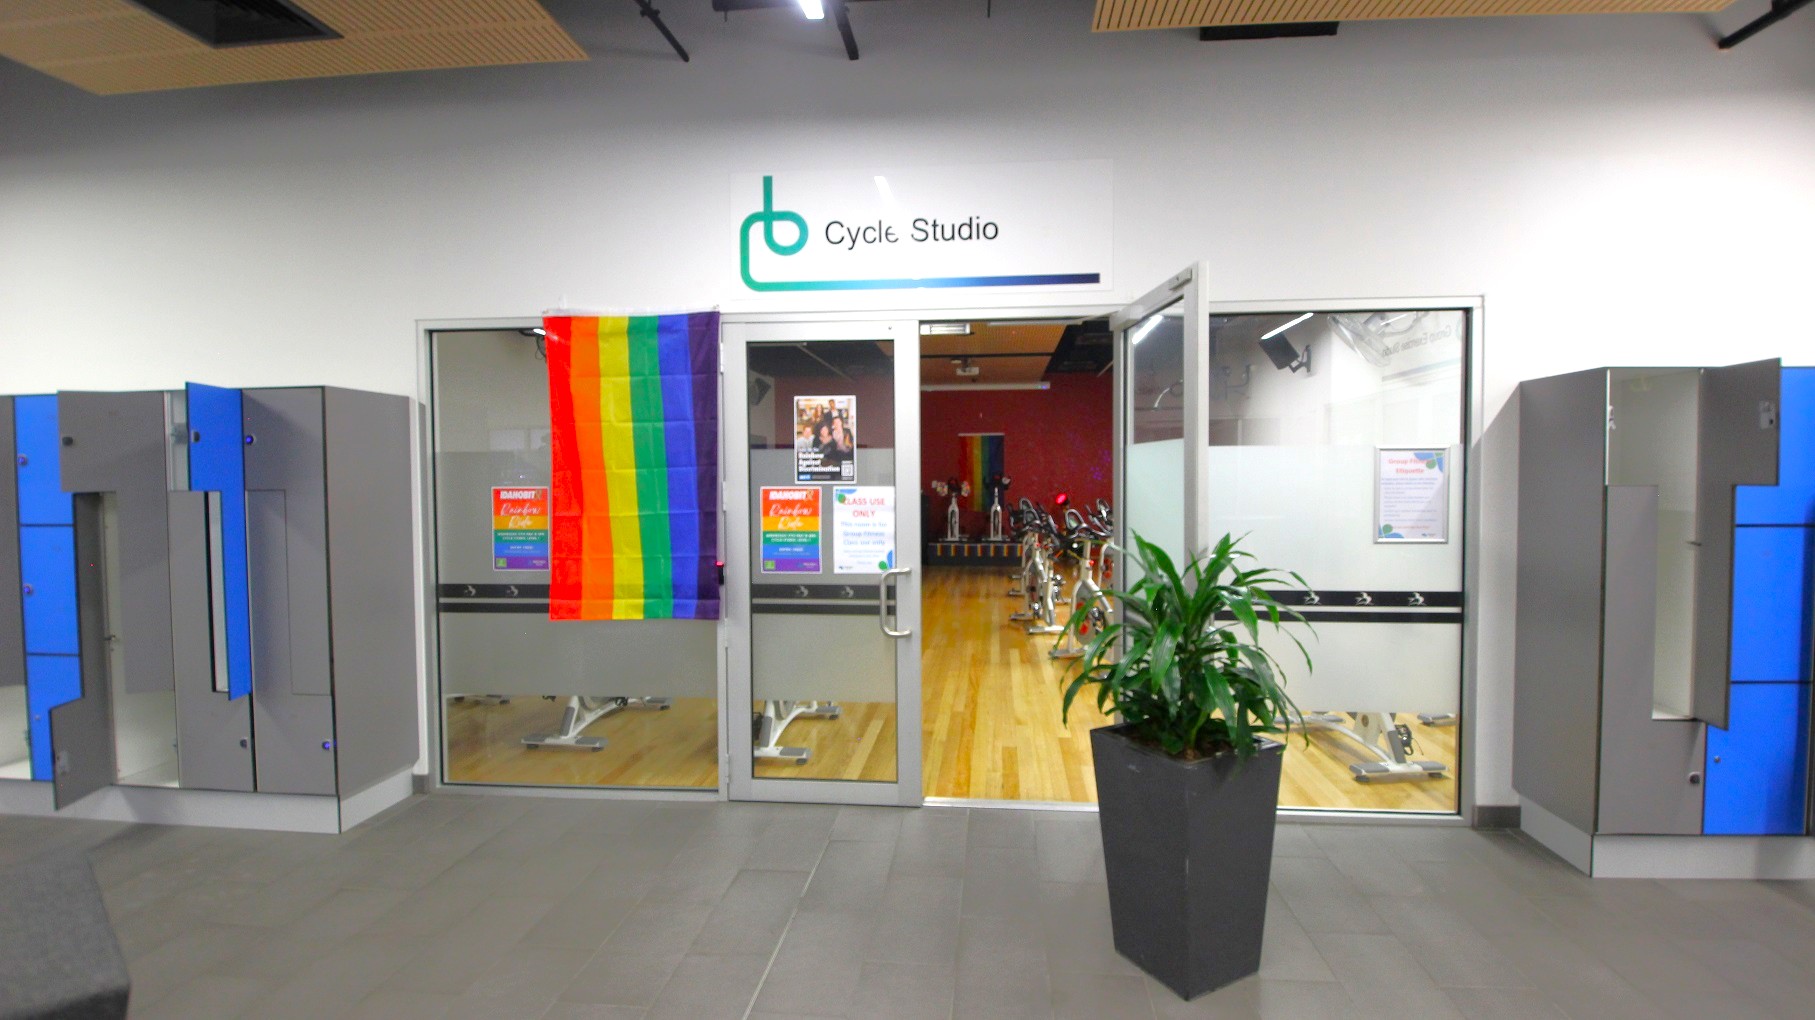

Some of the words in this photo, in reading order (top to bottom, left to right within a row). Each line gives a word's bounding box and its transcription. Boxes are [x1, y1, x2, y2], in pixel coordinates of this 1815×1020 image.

[825, 220, 899, 251] Cycle
[911, 216, 999, 242] Studio
[500, 490, 536, 499] IDAHOBIT
[500, 503, 540, 516] Rainbow
[769, 503, 812, 517] Rainbow
[853, 510, 876, 518] ONLY
